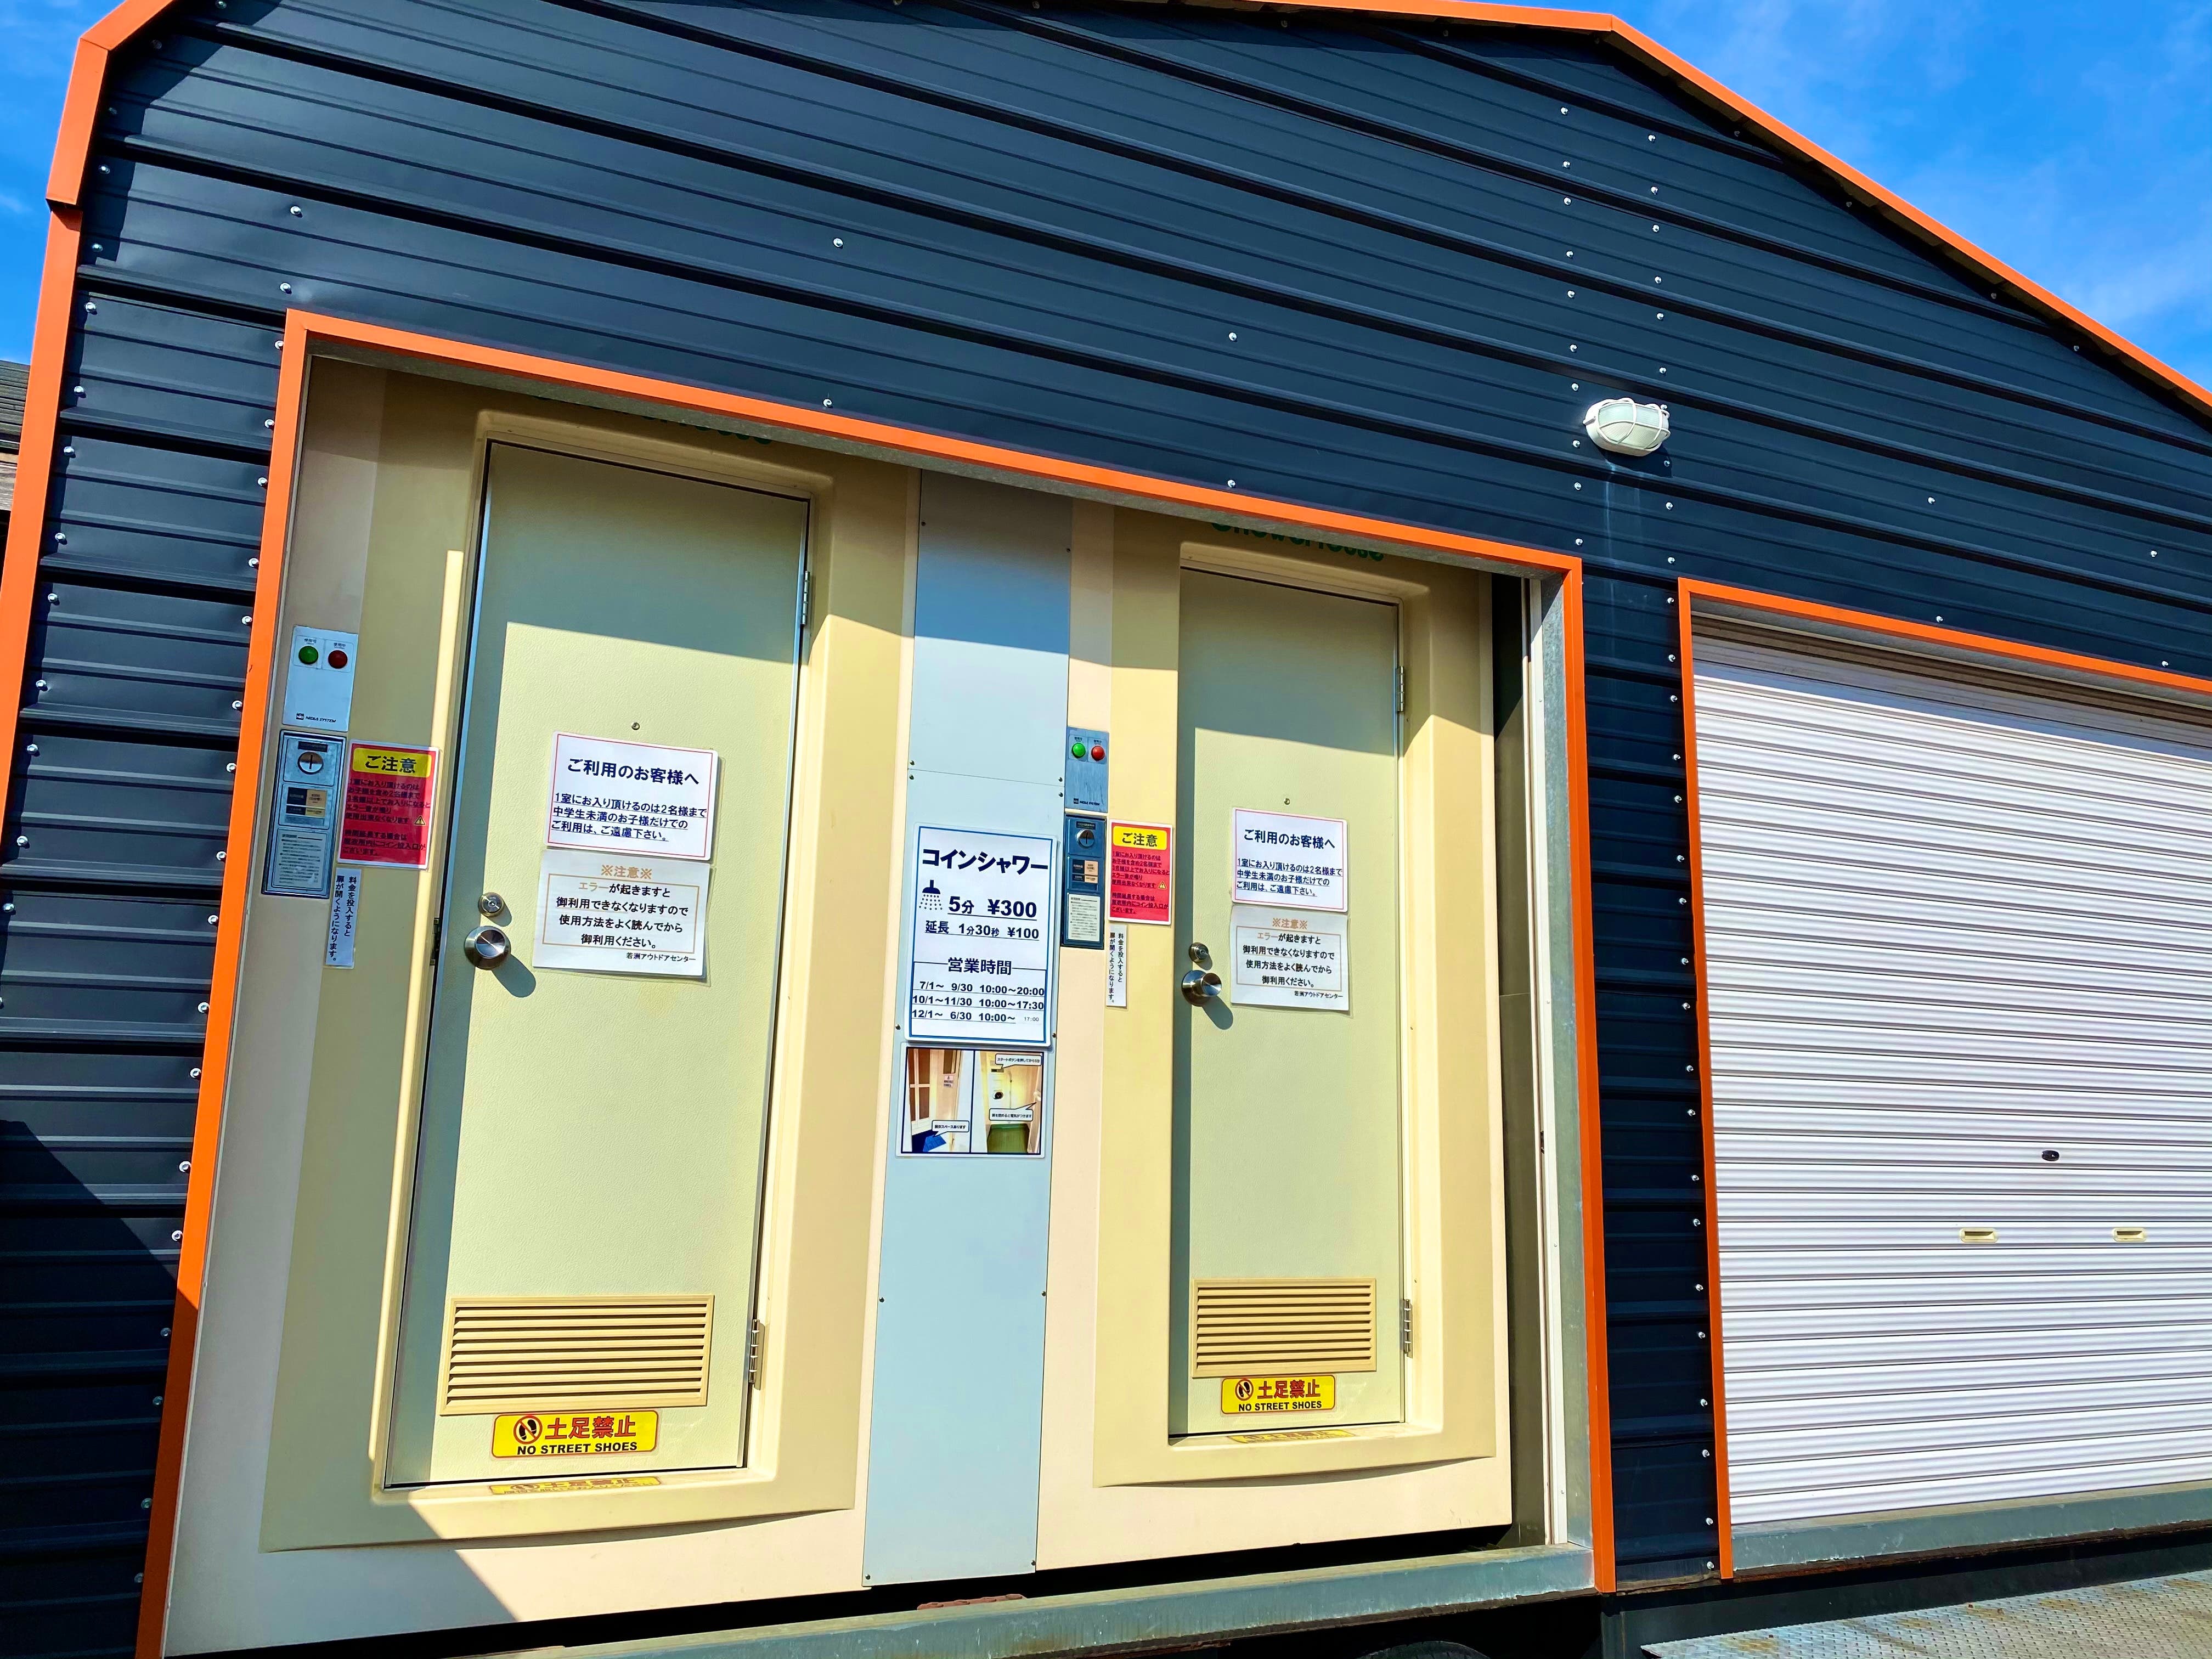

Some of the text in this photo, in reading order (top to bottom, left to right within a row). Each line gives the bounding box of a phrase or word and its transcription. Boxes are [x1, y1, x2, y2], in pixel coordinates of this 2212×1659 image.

[365, 755, 417, 774] ご注意
[567, 758, 699, 785] ご利用のお客様へ
[555, 792, 707, 817] 1室にお入り頂けるのは2名様まで
[553, 806, 689, 829] 中学生未満のお子様だけでの
[551, 820, 668, 841] ご利用は、ご遠慮下さい。
[1122, 832, 1158, 847] ご注意
[1244, 829, 1335, 849] ご利用のお客様へ
[922, 849, 1048, 875] コインシャワー
[1238, 858, 1342, 876] 1室にお入り頂けるのは2名様まで
[601, 864, 653, 879] ※注意※
[1237, 870, 1330, 885] 中学生未満のお子様だけでの
[578, 881, 671, 898] エラーが起きますと
[1237, 881, 1316, 896] ご利用は、ご遠慮下さい。
[344, 876, 357, 936] 料金を投入すると
[556, 896, 689, 916] 御利用できなくなりますので
[948, 896, 1037, 918] 5分 ¥300
[328, 875, 345, 961] 扉が開くようになります。
[559, 915, 683, 933] 使用方法をよく読んでから
[926, 920, 1039, 939] 延長 1分30秒 ¥100
[1257, 932, 1321, 945] エラーが起きますと
[581, 934, 657, 949] 御利用ください。
[1243, 945, 1335, 960] 御利用できなくなりますので
[947, 957, 1012, 975] 営業時間
[1246, 960, 1332, 974] 使用方法をよく読んでから
[951, 983, 973, 992] 9/30
[1262, 975, 1314, 988] 御利用ください。
[950, 1011, 972, 1020] 6/30
[1257, 1379, 1321, 1399] 土足禁止
[1238, 1401, 1322, 1412] NO STREET SHOES
[544, 1415, 636, 1440] 土足禁止
[517, 1442, 637, 1455] NO STREET SHOES
